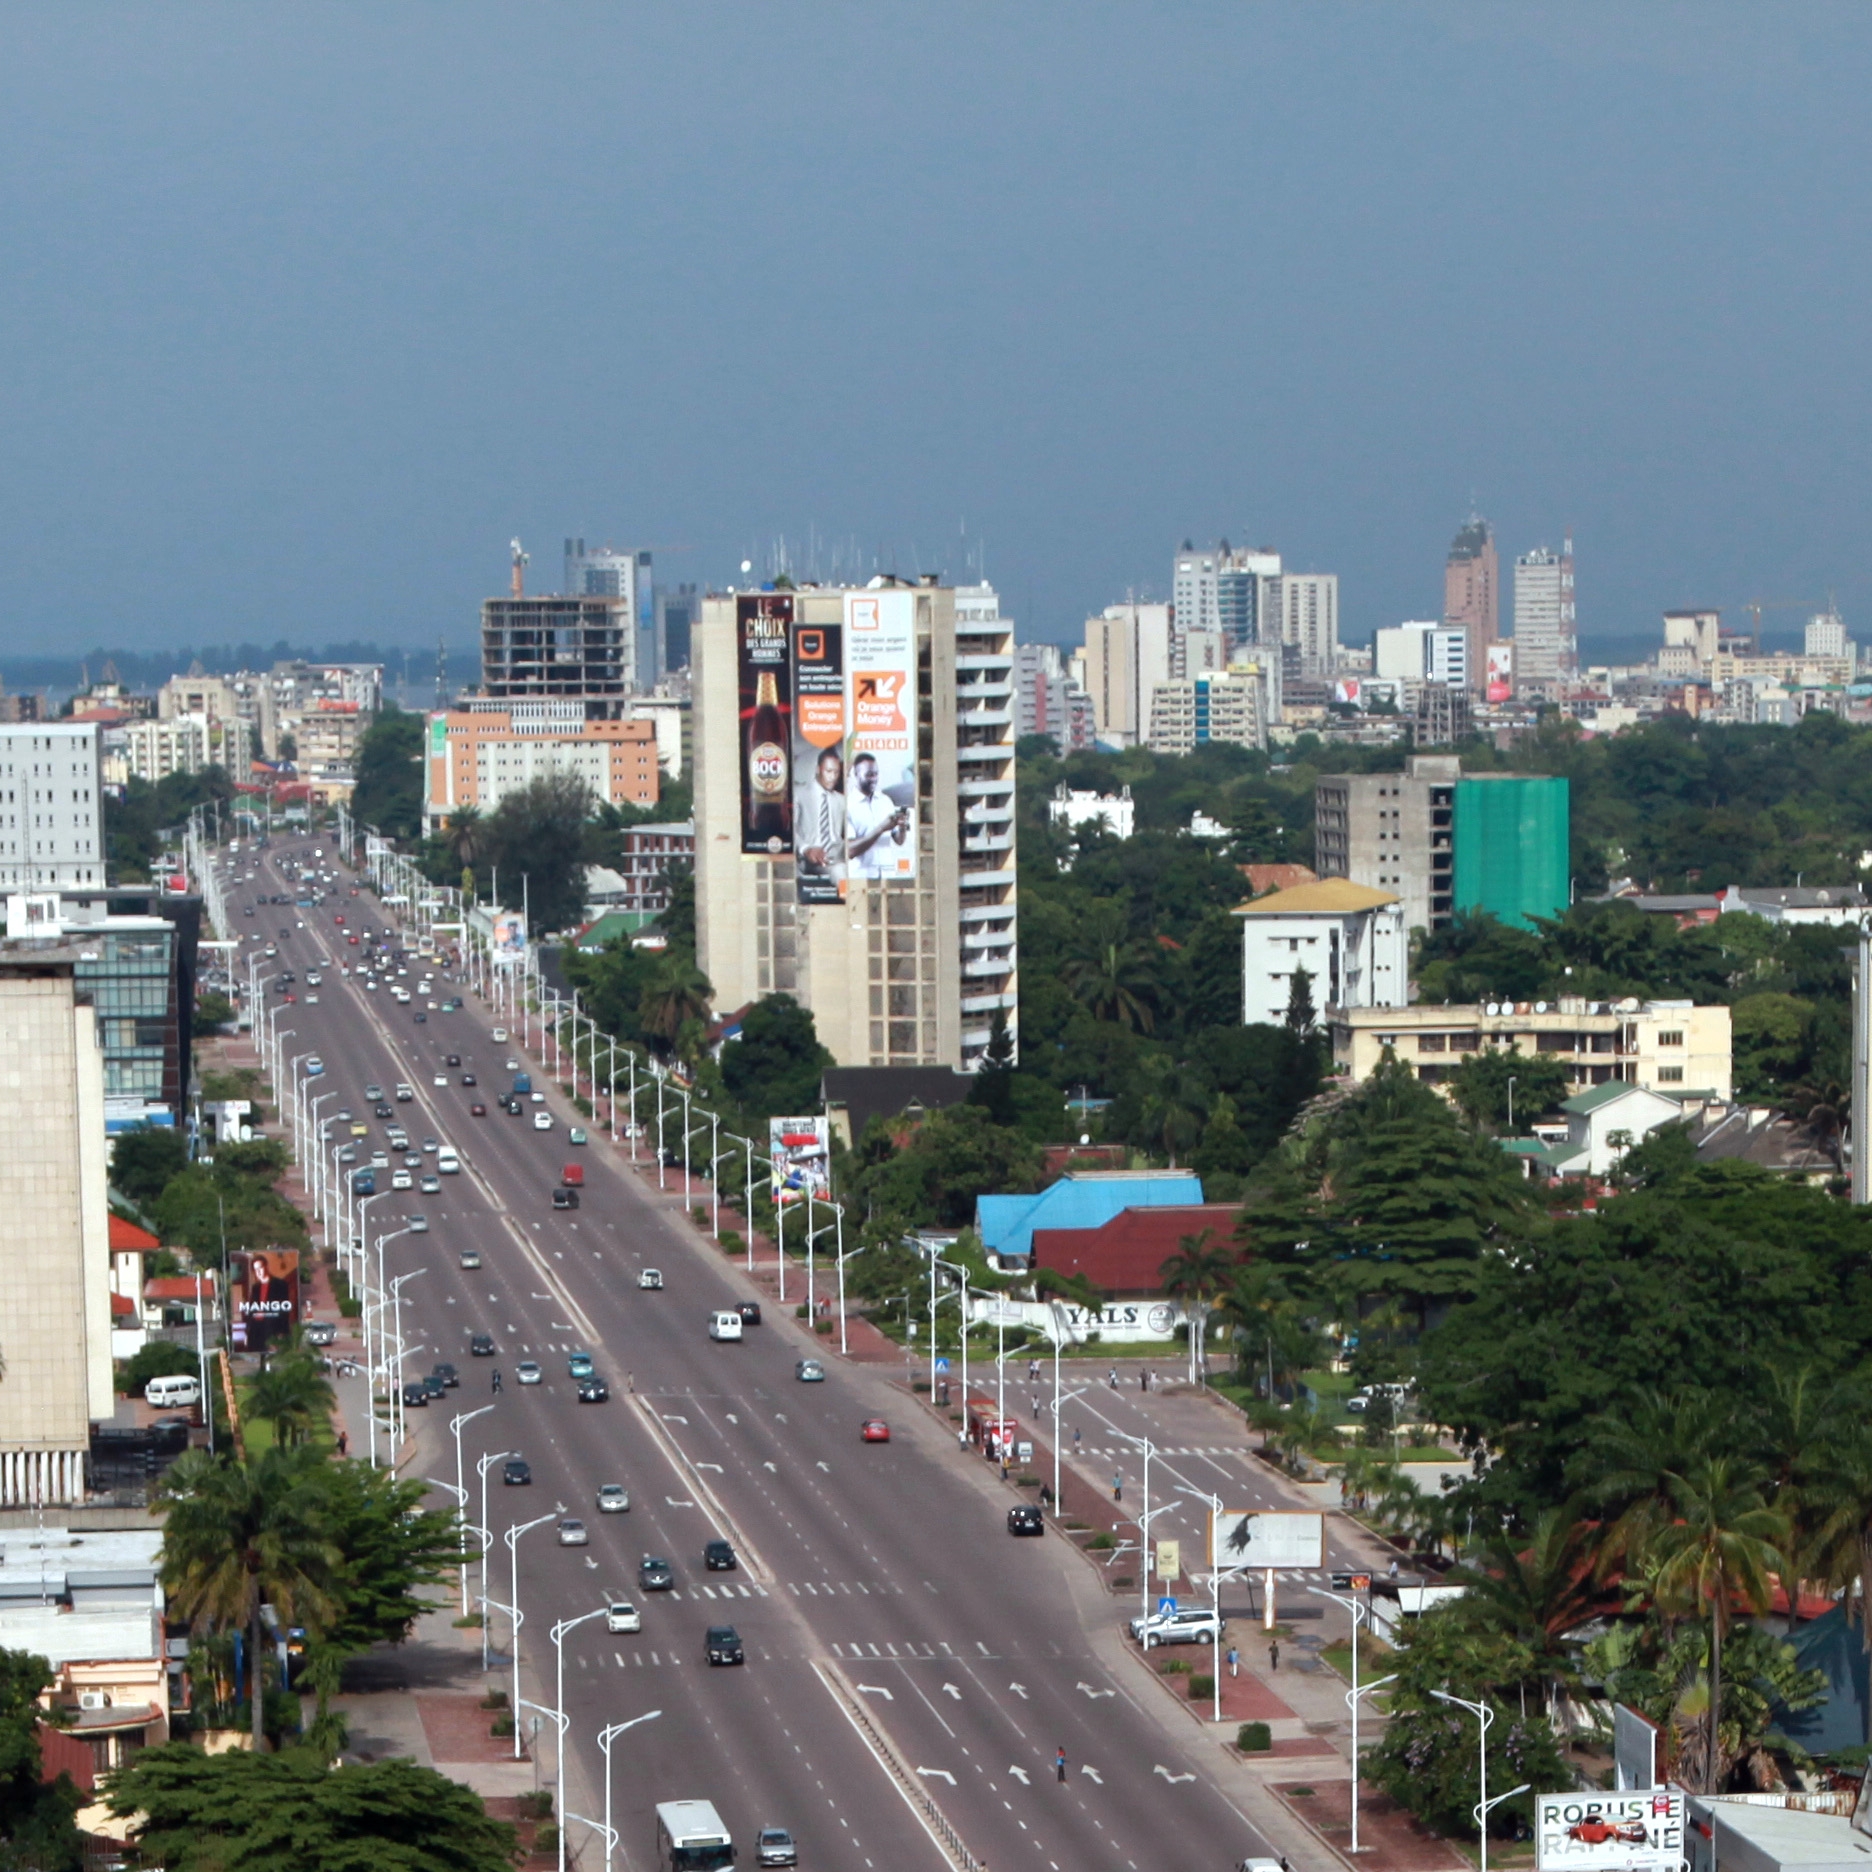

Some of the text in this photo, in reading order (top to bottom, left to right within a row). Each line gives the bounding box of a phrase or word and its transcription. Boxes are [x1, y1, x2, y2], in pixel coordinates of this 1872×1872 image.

[757, 599, 773, 617] LE
[745, 618, 786, 637] CHOIX
[857, 701, 896, 714] Orange
[808, 711, 837, 722] Orange
[857, 713, 893, 726] Money
[753, 760, 783, 774] BOCK
[239, 1300, 292, 1312] MANGO
